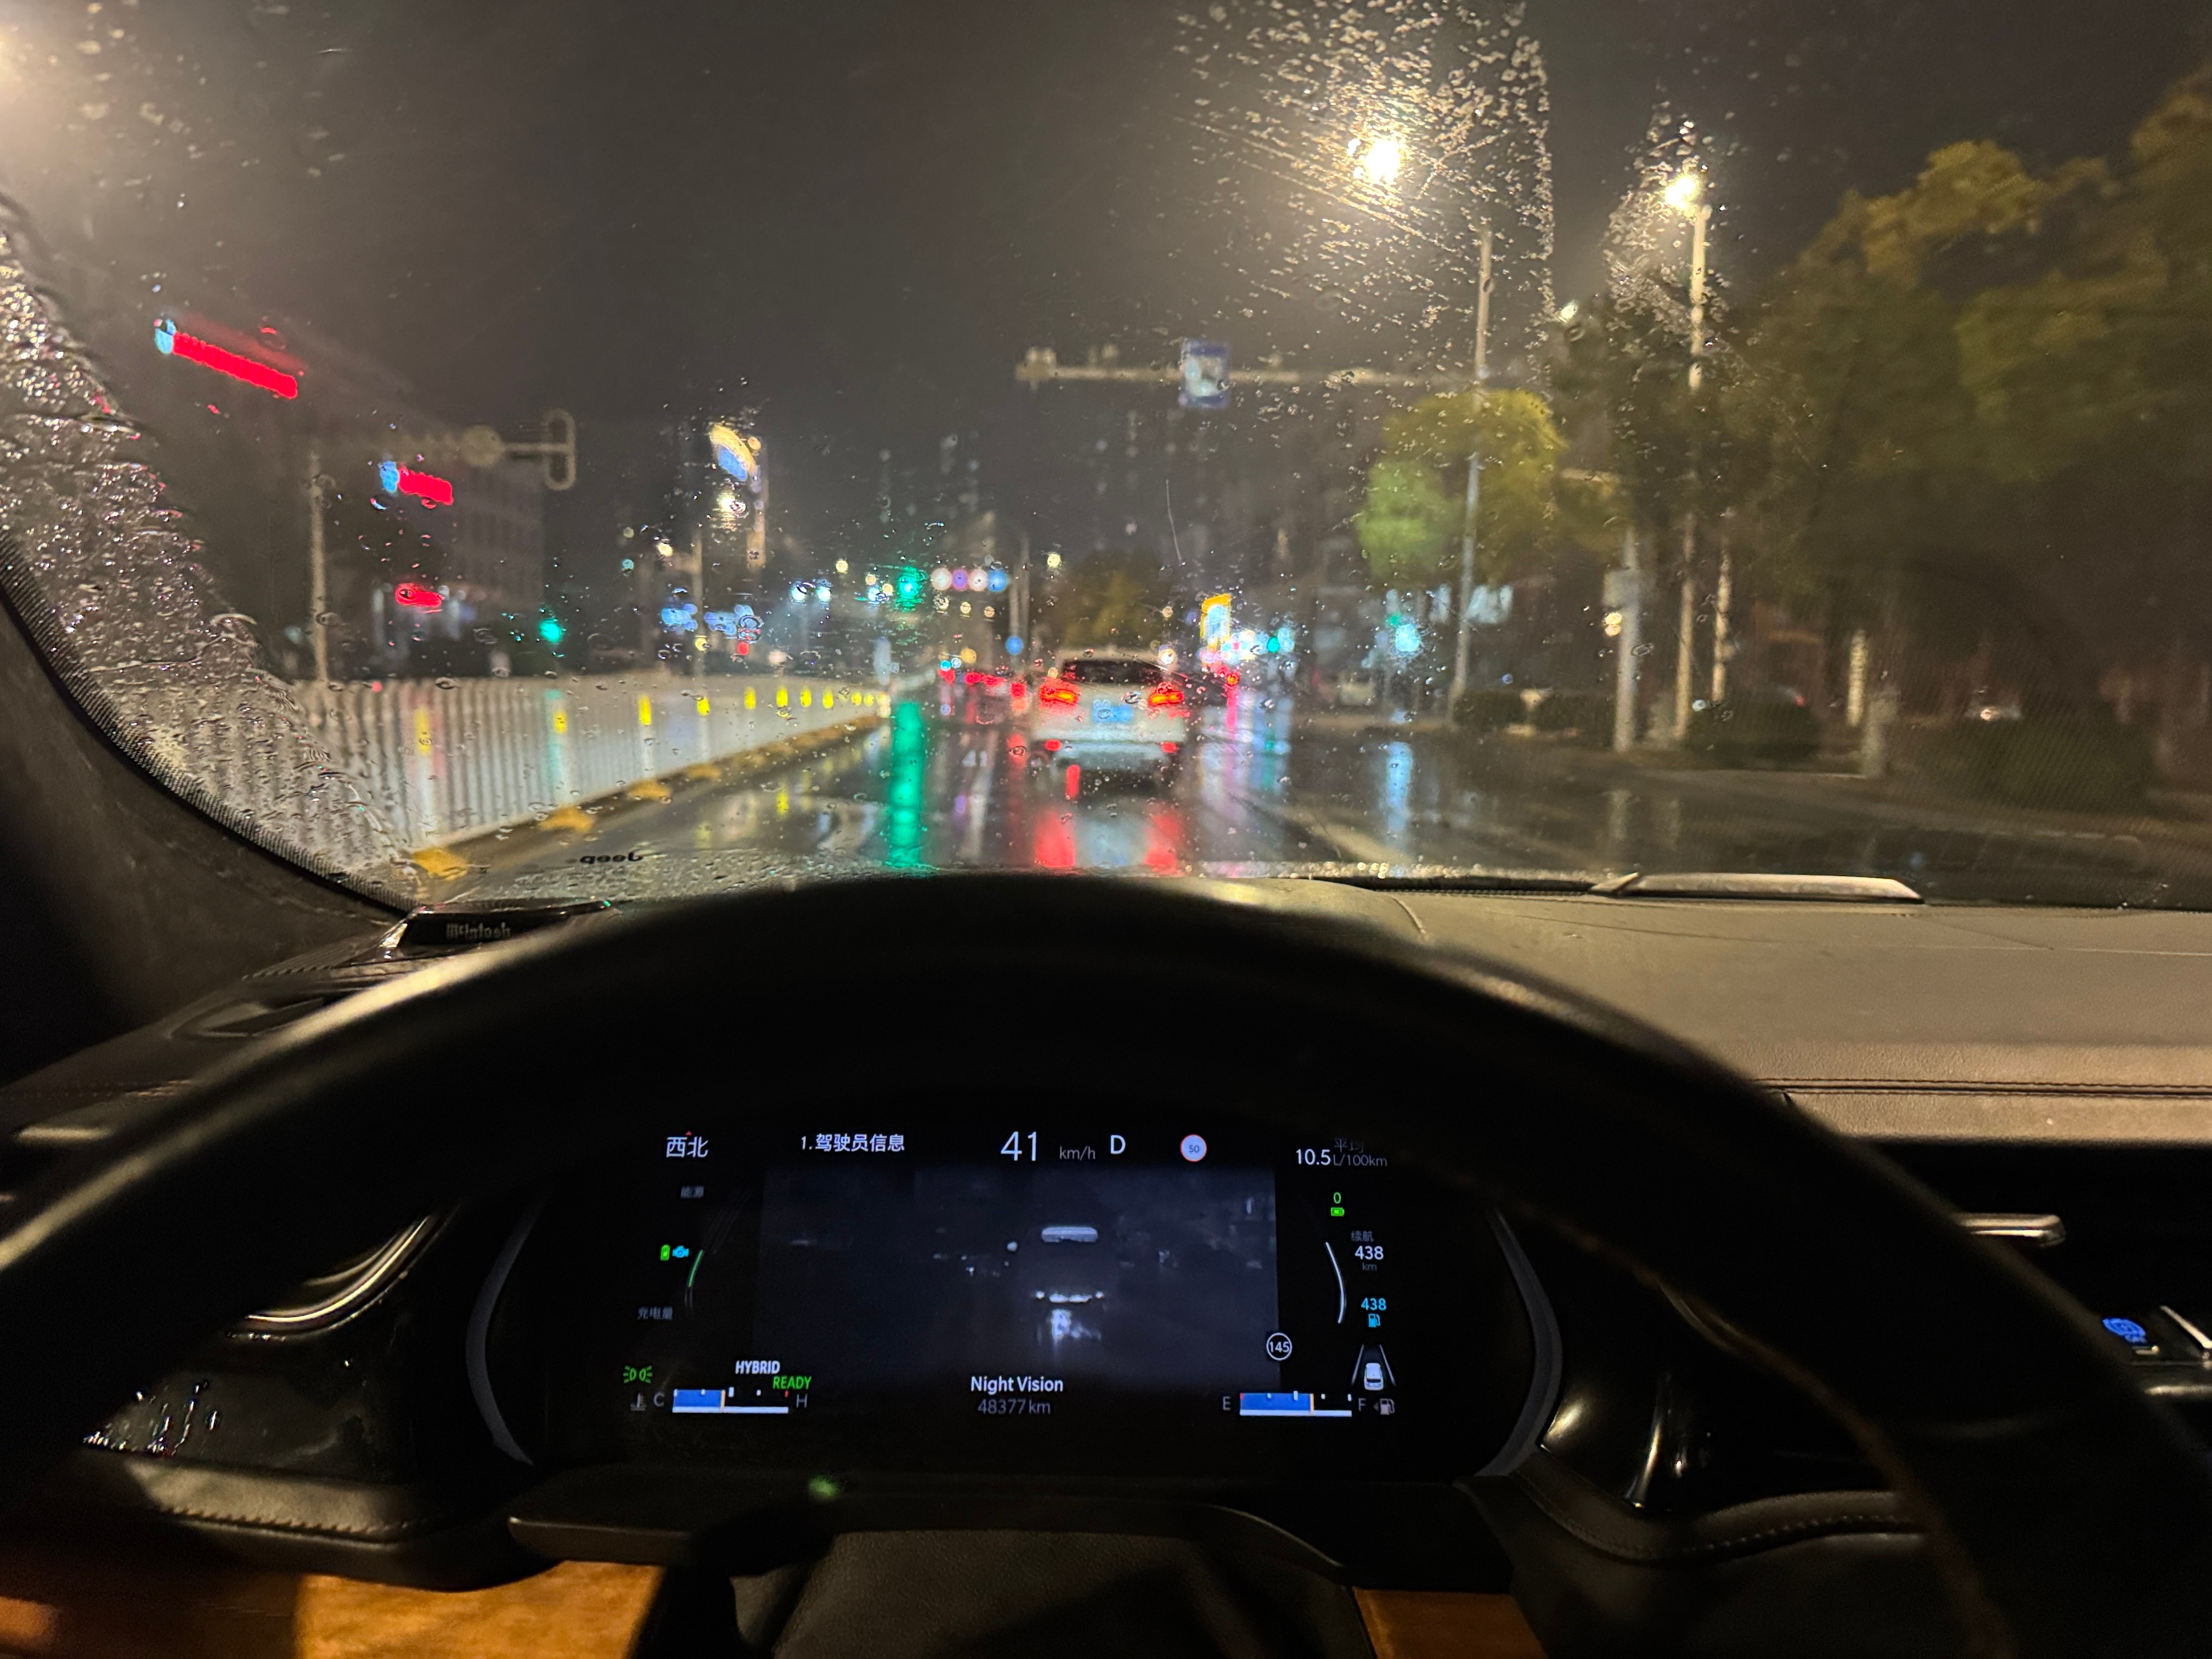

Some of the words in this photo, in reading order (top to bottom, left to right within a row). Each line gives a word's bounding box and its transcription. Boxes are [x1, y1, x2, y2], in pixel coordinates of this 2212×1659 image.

[666, 1137, 708, 1158] 西北
[1001, 1131, 1036, 1161] 41
[1060, 1146, 1095, 1160] km/h
[1110, 1135, 1125, 1154] D
[1189, 1144, 1199, 1153] 50
[1296, 1149, 1330, 1165] 10.5
[1333, 1153, 1387, 1166] L/100km
[1334, 1192, 1341, 1204] 0
[1351, 1231, 1374, 1242] 续航
[1355, 1246, 1384, 1260] 438
[1362, 1262, 1377, 1271] km
[1361, 1298, 1386, 1311] 438
[1269, 1341, 1290, 1353] 145
[736, 1361, 780, 1374] HYBRID
[773, 1376, 811, 1389] READY
[971, 1376, 1014, 1395] Night
[1017, 1376, 1063, 1391] Vision
[653, 1391, 664, 1407] C
[796, 1394, 807, 1408] H
[978, 1398, 1026, 1414] 48377
[1029, 1400, 1050, 1413] km
[1223, 1396, 1230, 1410] E
[1358, 1398, 1365, 1411] F
